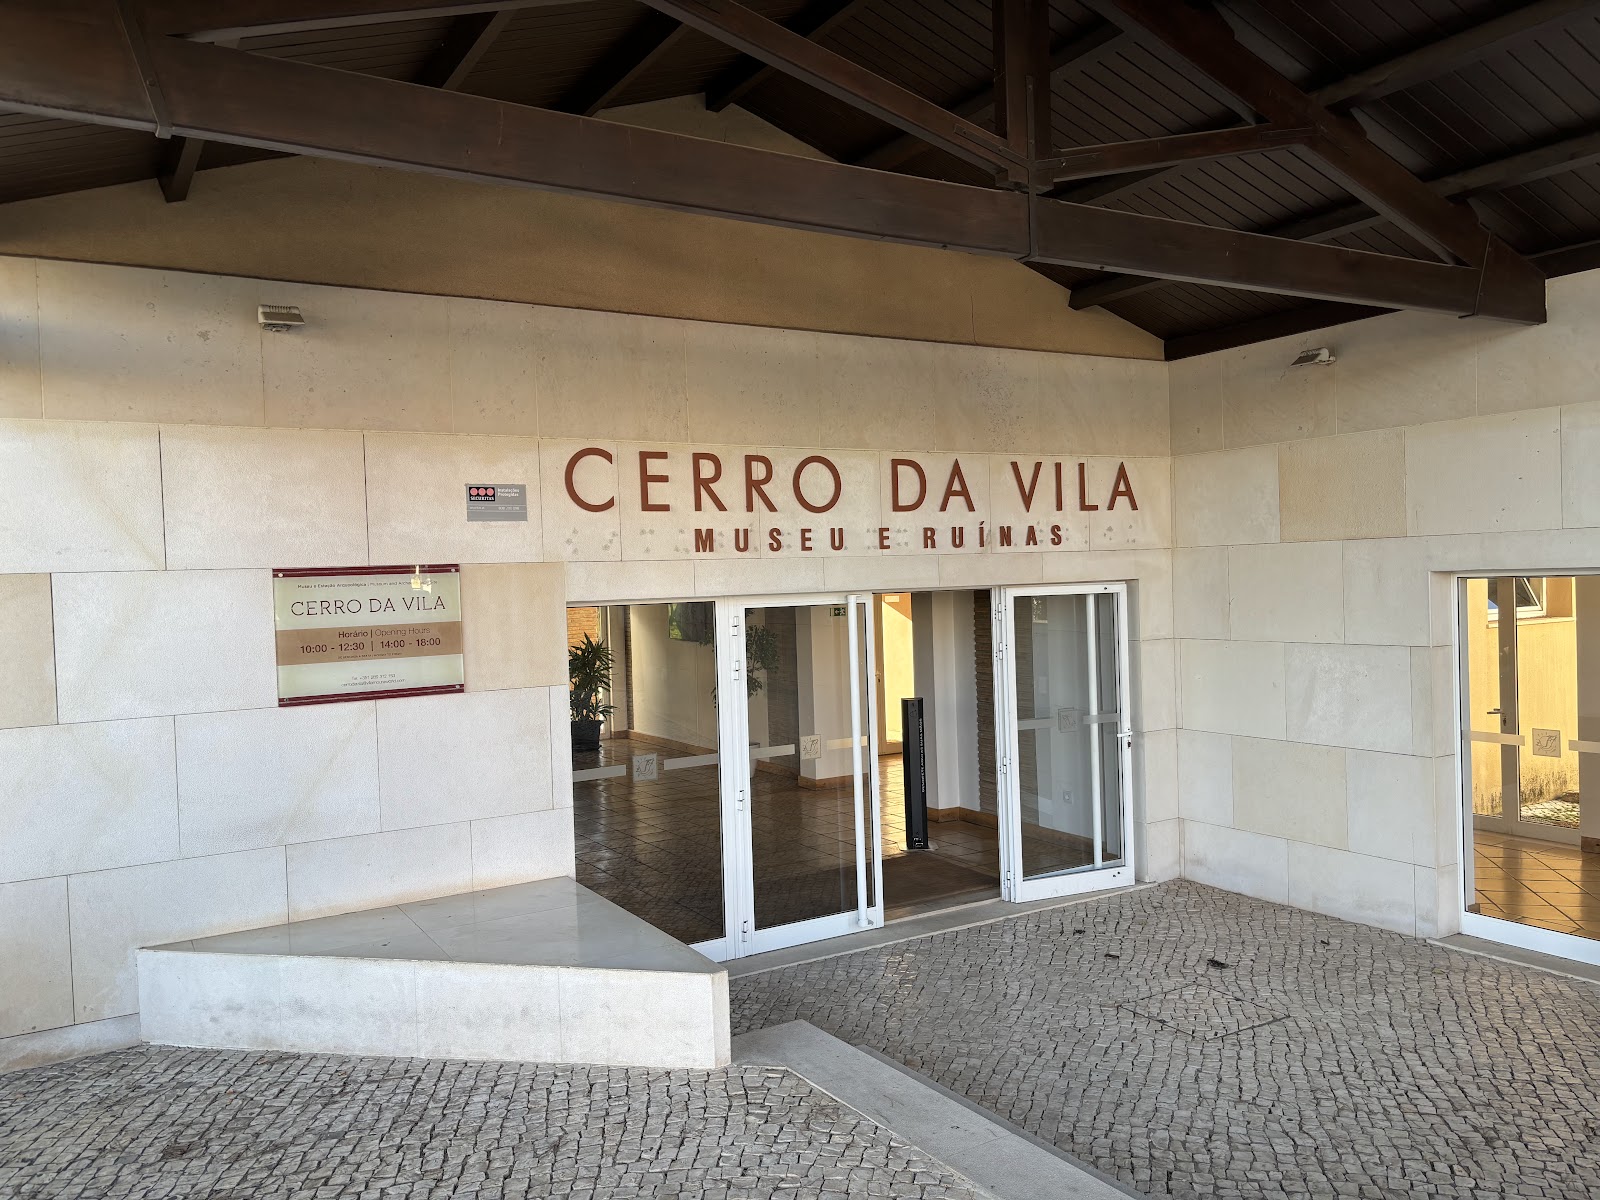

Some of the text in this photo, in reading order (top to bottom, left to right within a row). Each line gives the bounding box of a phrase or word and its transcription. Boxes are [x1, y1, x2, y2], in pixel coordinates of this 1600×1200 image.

[564, 447, 1139, 514] CERRO DA VILA
[694, 520, 1064, 554] MUSEU E RUÍNAS
[291, 595, 446, 616] CERRO DA VILA
[338, 630, 368, 638] Horário
[374, 628, 407, 638] Opening
[408, 627, 431, 635] Hours
[300, 644, 328, 654] 10:00
[338, 642, 365, 652] 12:30
[380, 639, 406, 649] 14:00
[416, 637, 441, 647] 18:00
